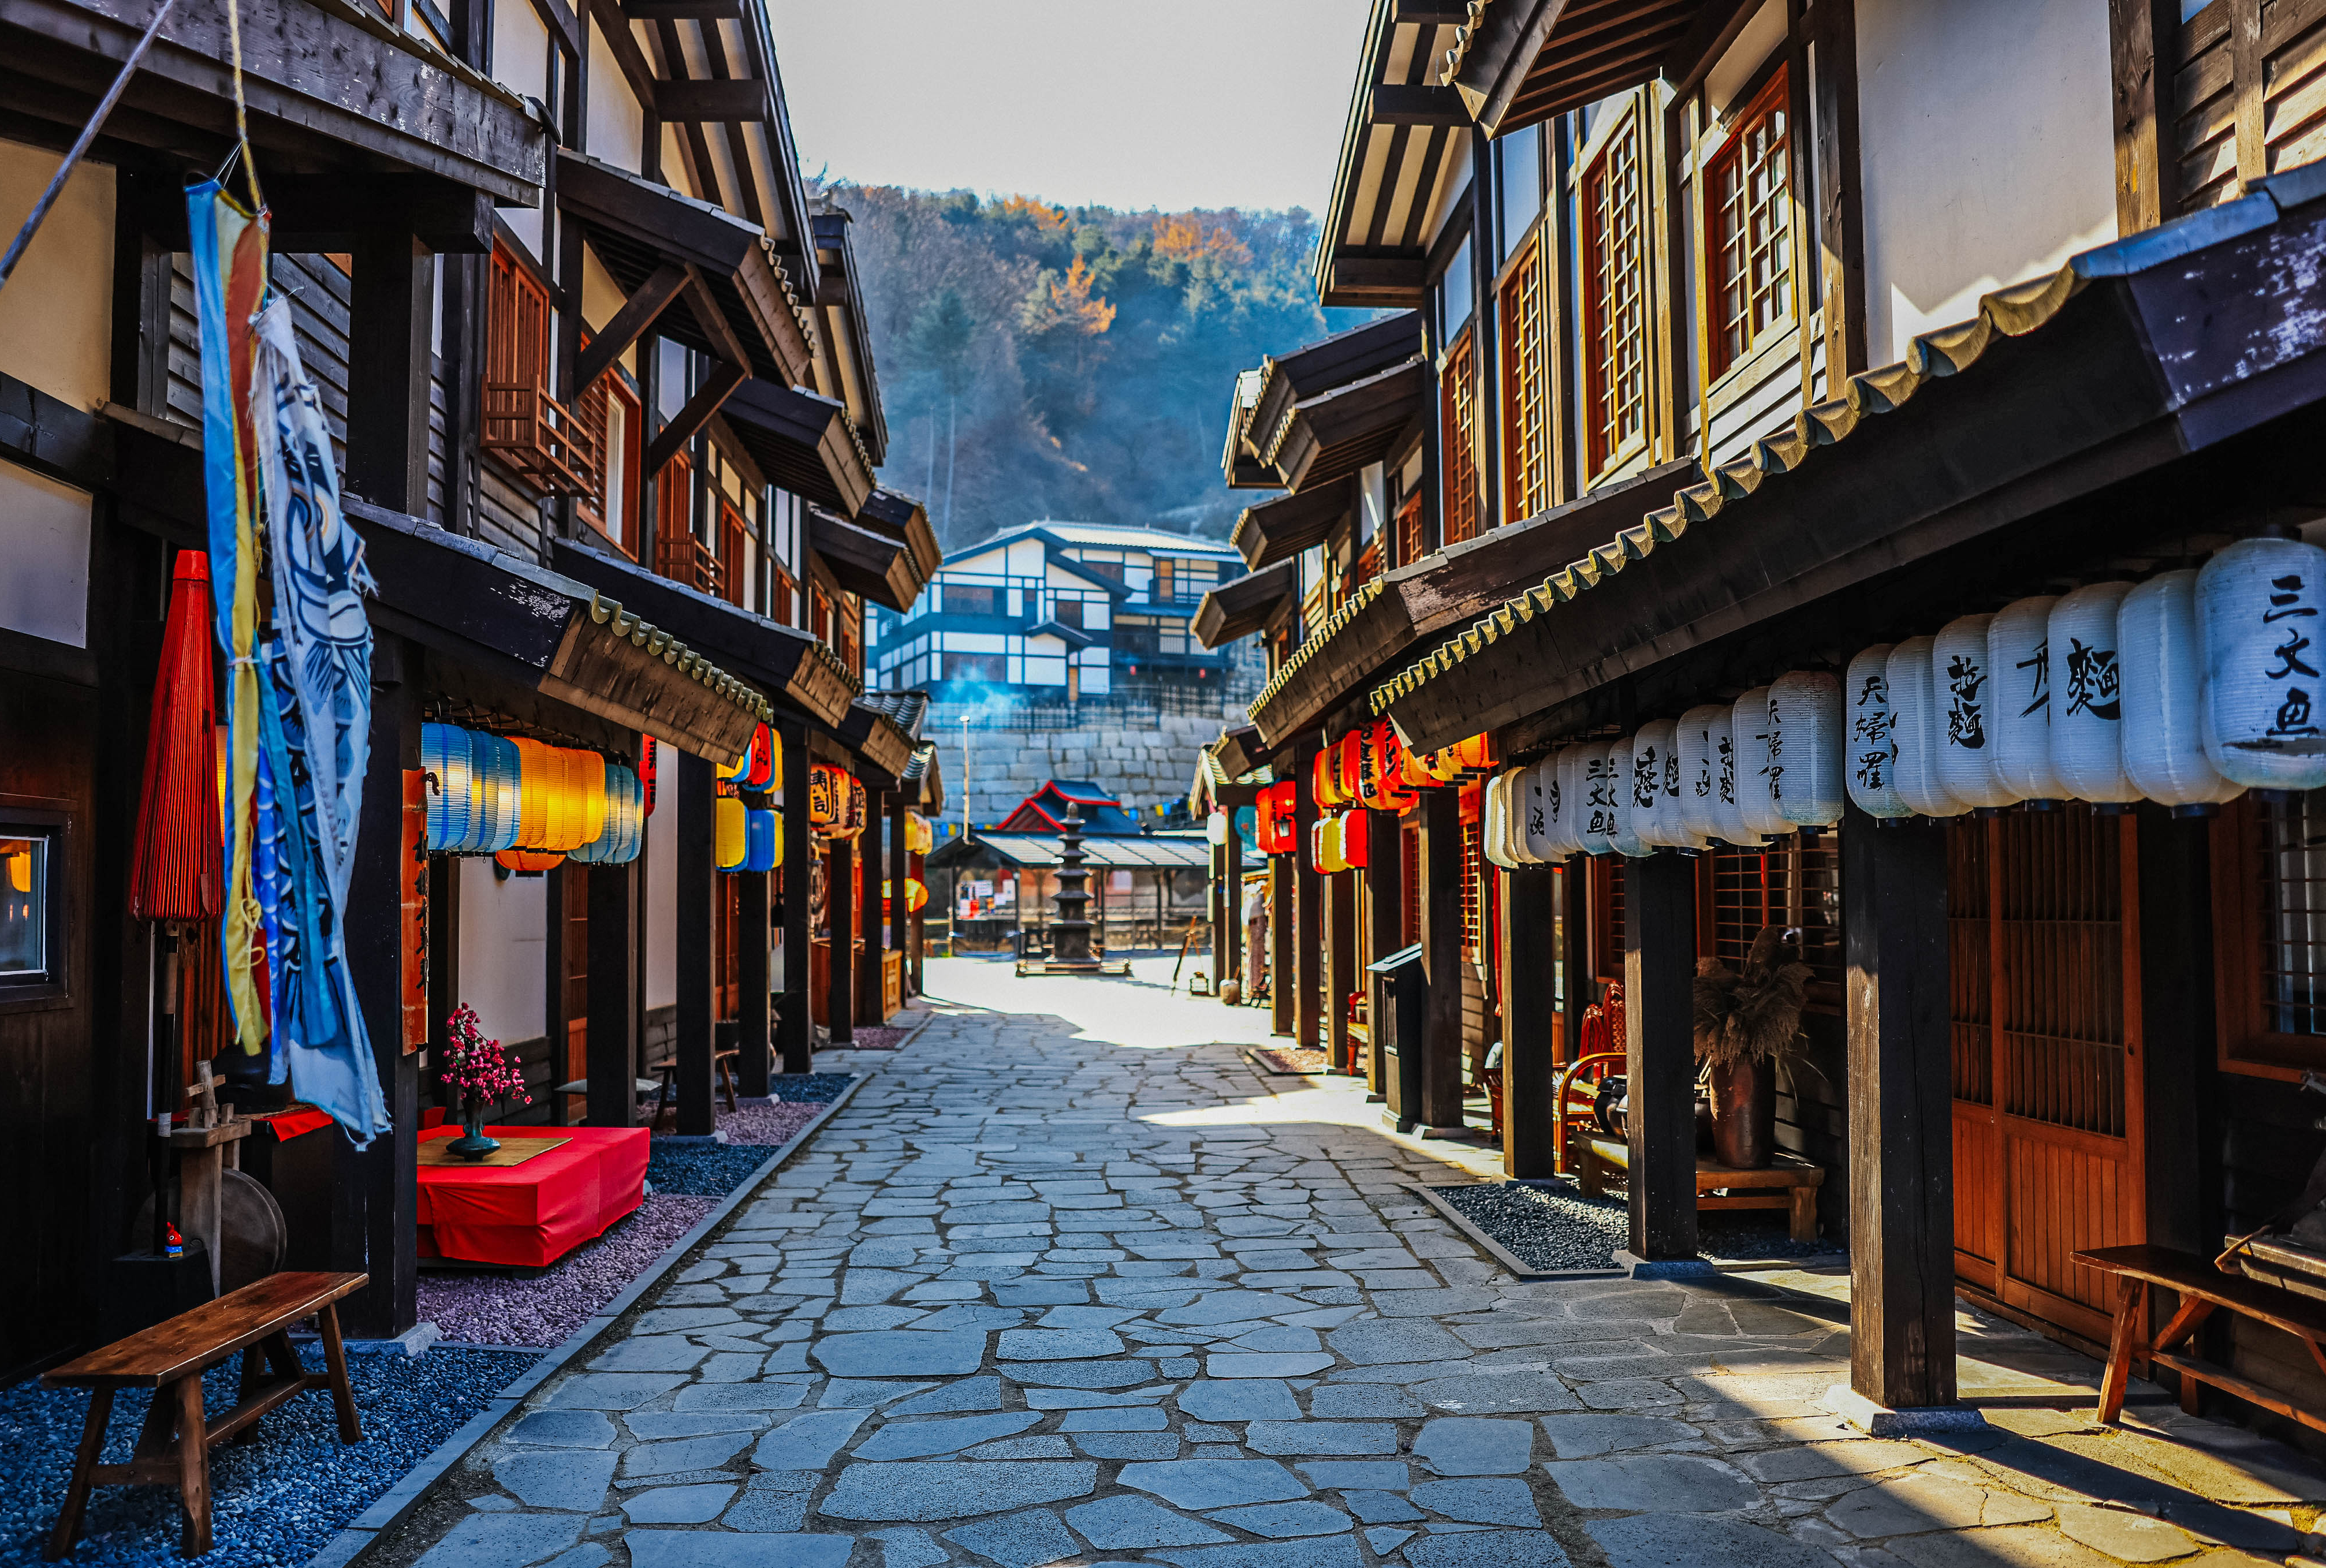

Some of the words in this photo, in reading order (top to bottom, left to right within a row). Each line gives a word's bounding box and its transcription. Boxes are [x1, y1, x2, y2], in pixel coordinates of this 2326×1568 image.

[2262, 575, 2320, 737] 三文鱼
[1586, 759, 1608, 837] 三文鱼
